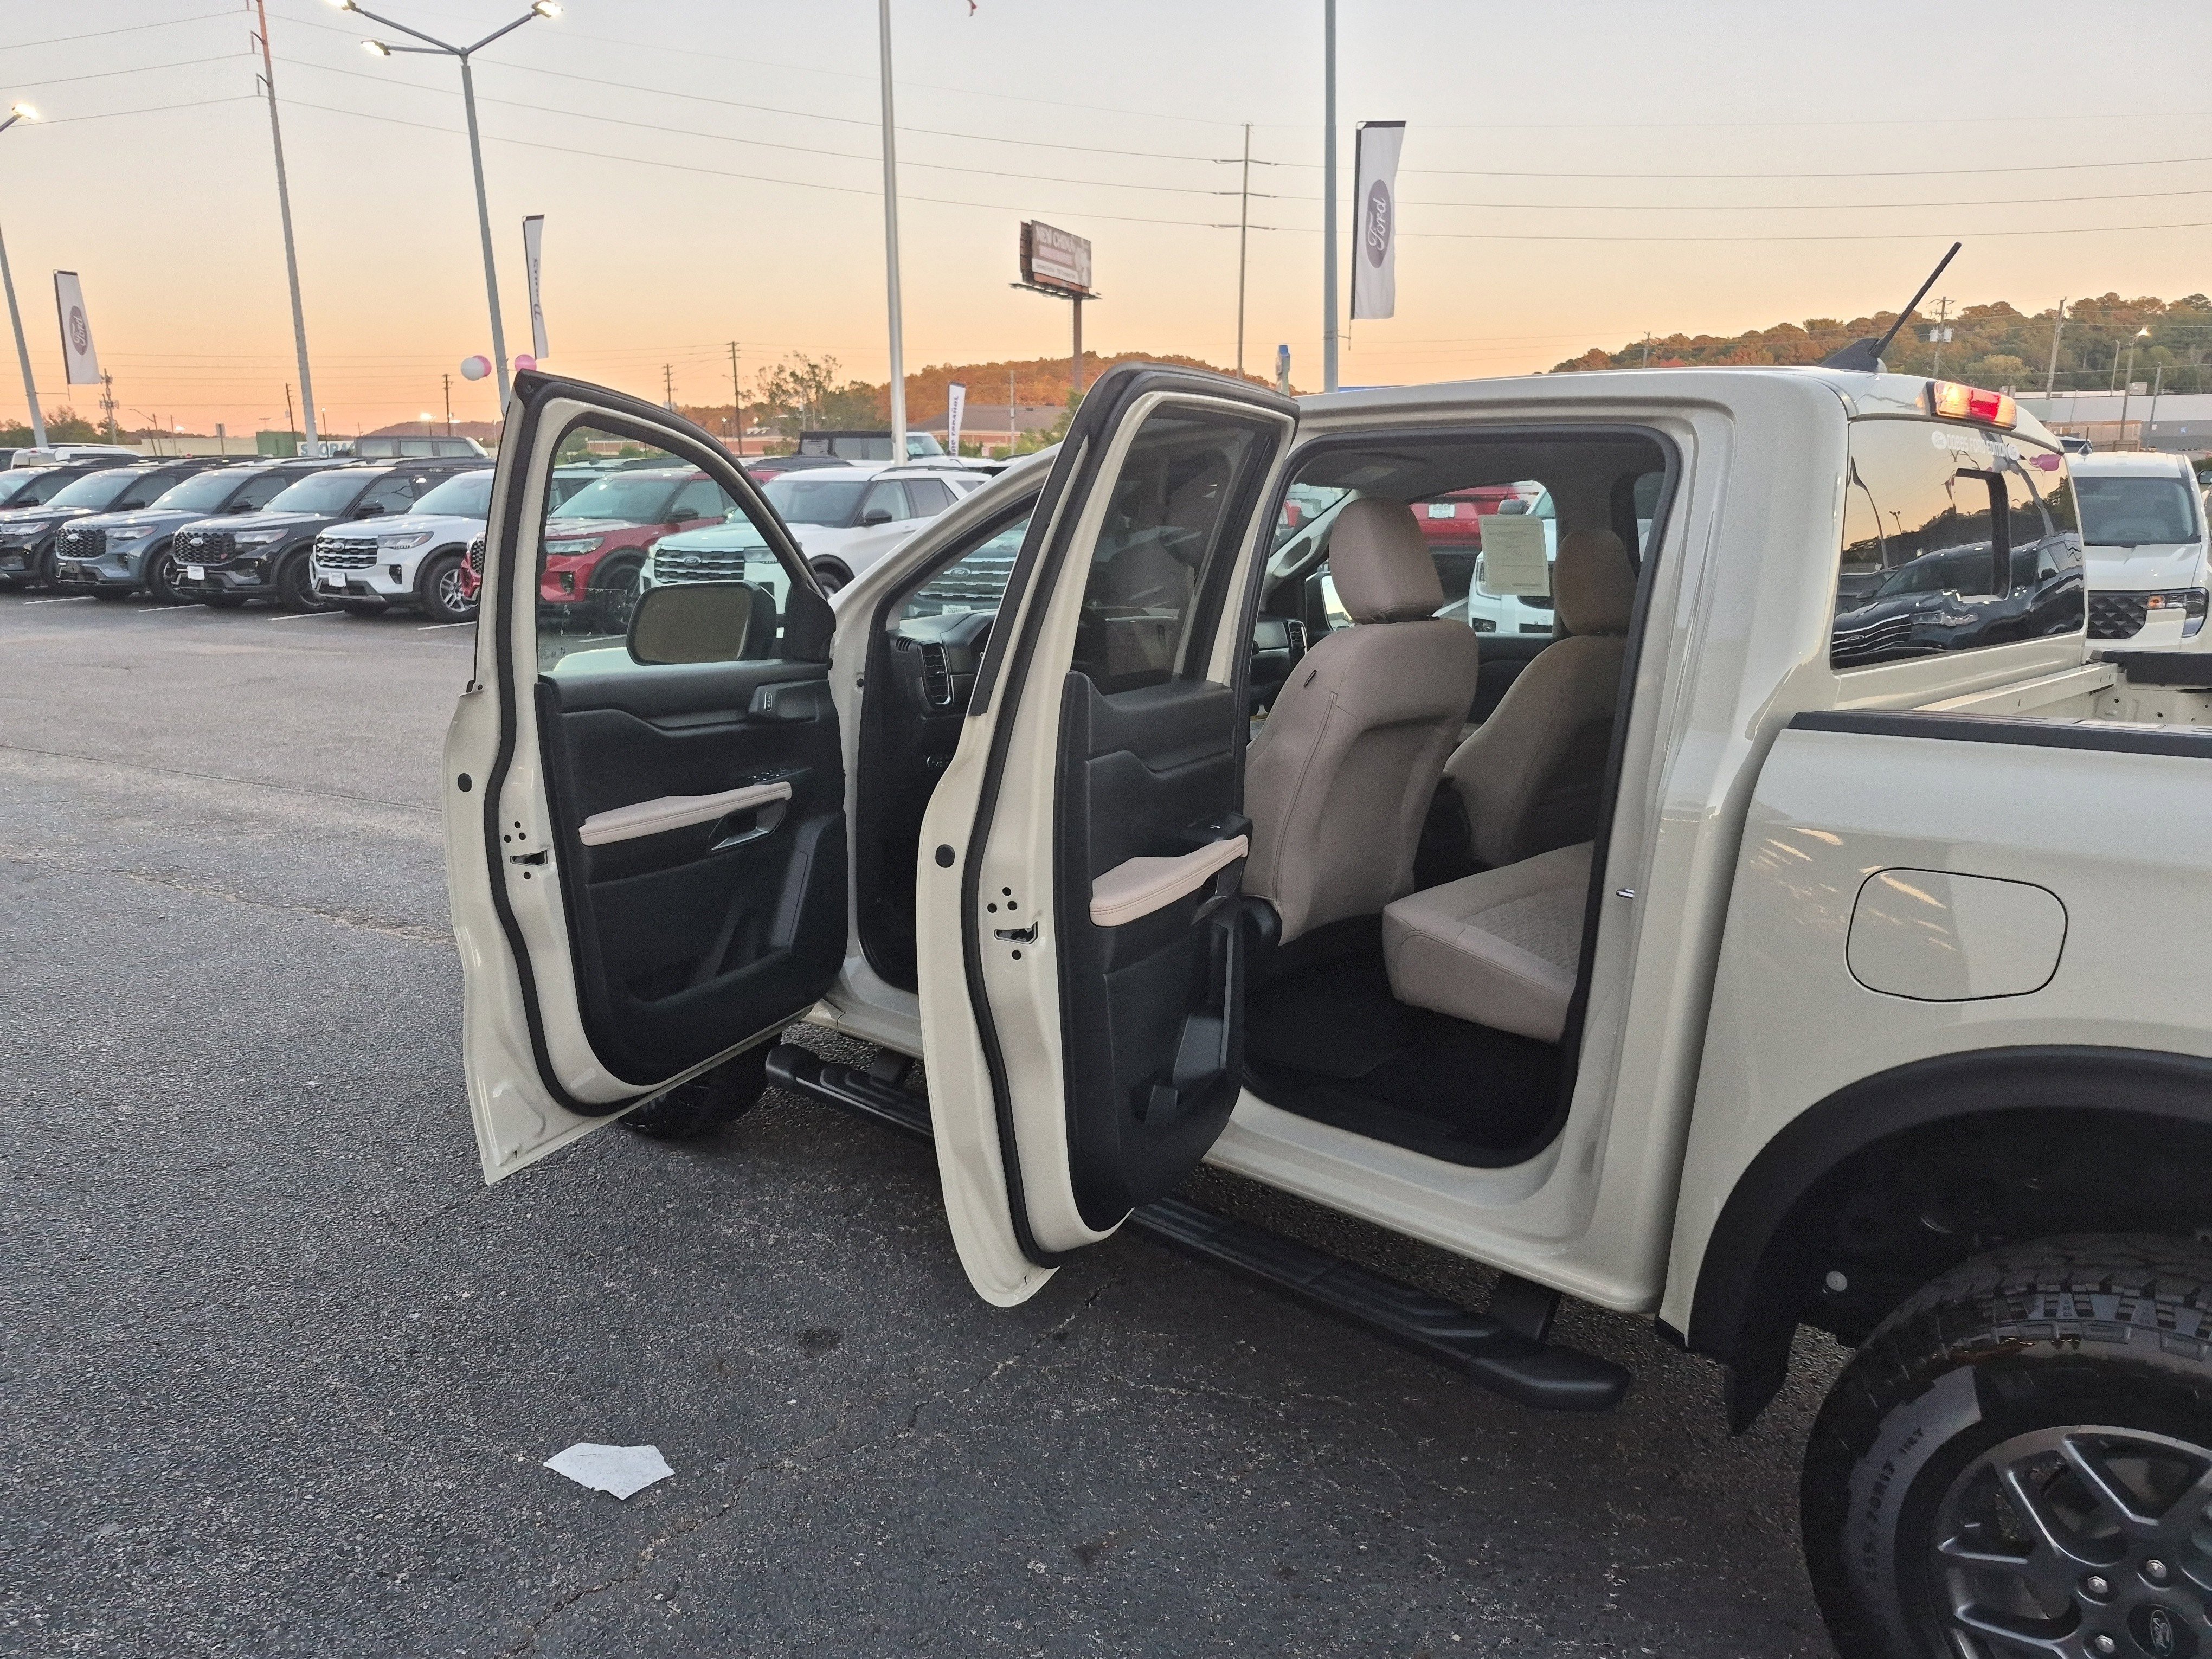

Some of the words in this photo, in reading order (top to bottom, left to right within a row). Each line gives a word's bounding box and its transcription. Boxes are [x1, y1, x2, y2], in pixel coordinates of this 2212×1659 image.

[1368, 198, 1386, 252] Ford
[71, 315, 86, 346] Ford
[301, 443, 356, 456] SORA
[1947, 434, 1969, 452] DOBBS
[1970, 438, 1986, 454] FORD
[1986, 440, 2010, 460] EDITION
[2153, 1617, 2170, 1648] Ford
